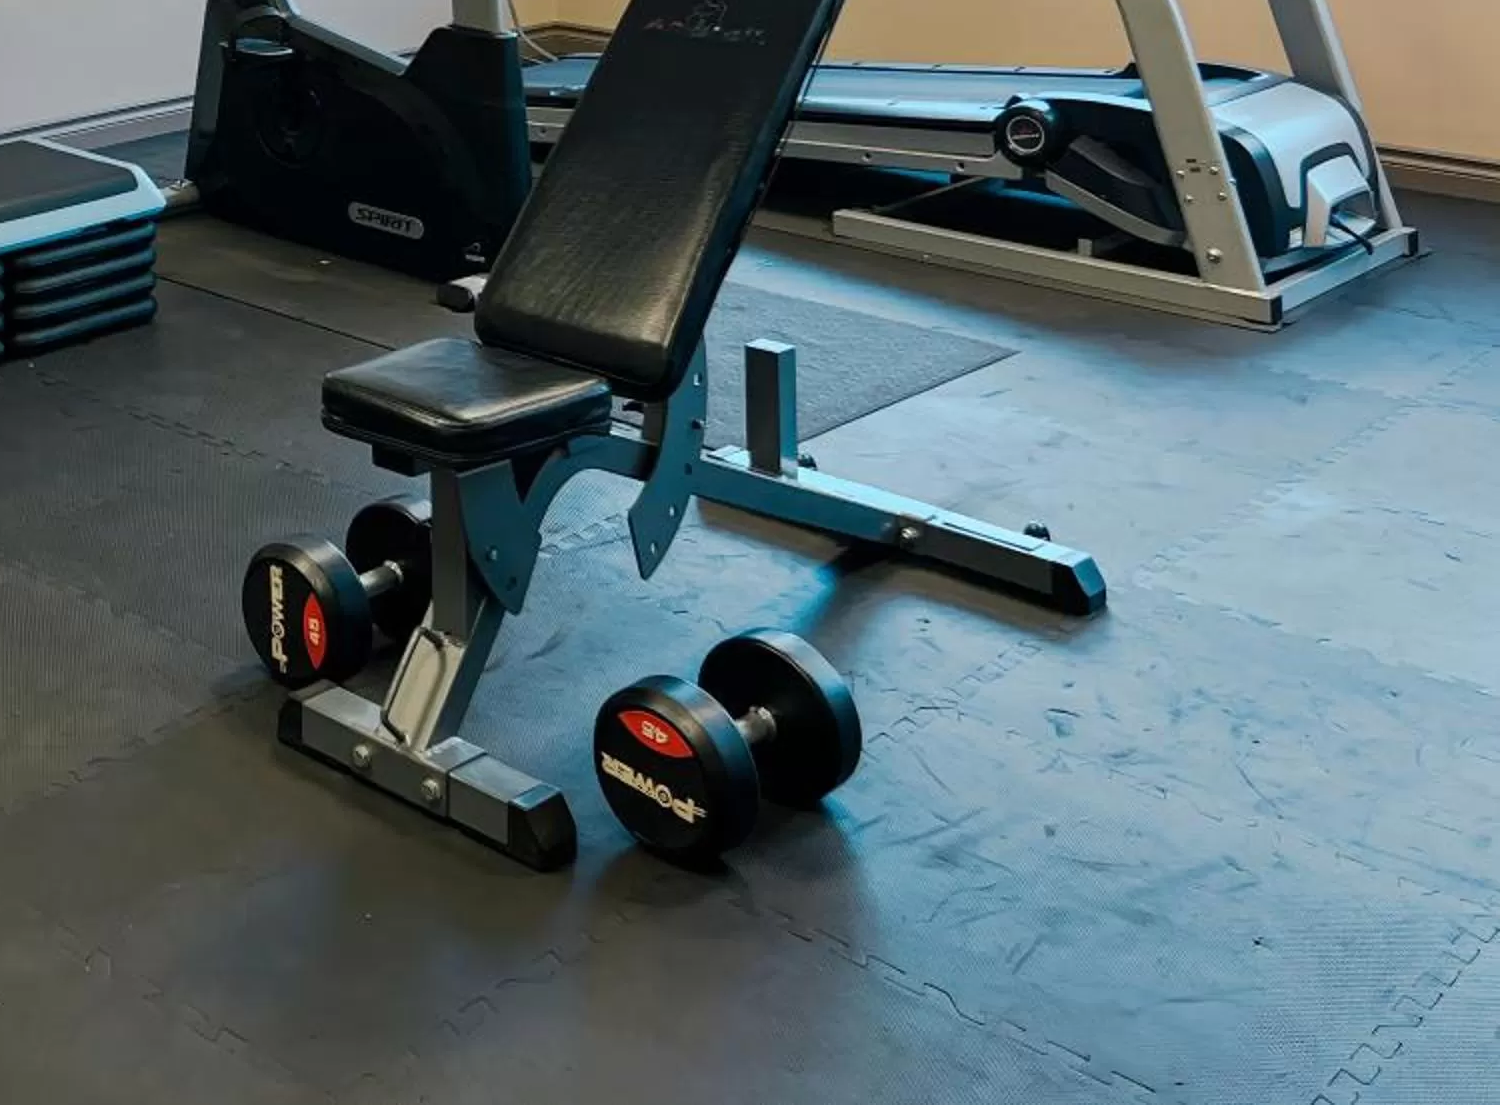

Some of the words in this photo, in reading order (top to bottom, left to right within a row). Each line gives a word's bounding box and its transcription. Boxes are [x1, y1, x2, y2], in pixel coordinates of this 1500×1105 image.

[270, 565, 288, 672] POWER
[307, 617, 320, 646] 45
[640, 720, 669, 744] 45
[601, 751, 708, 824] POWER
